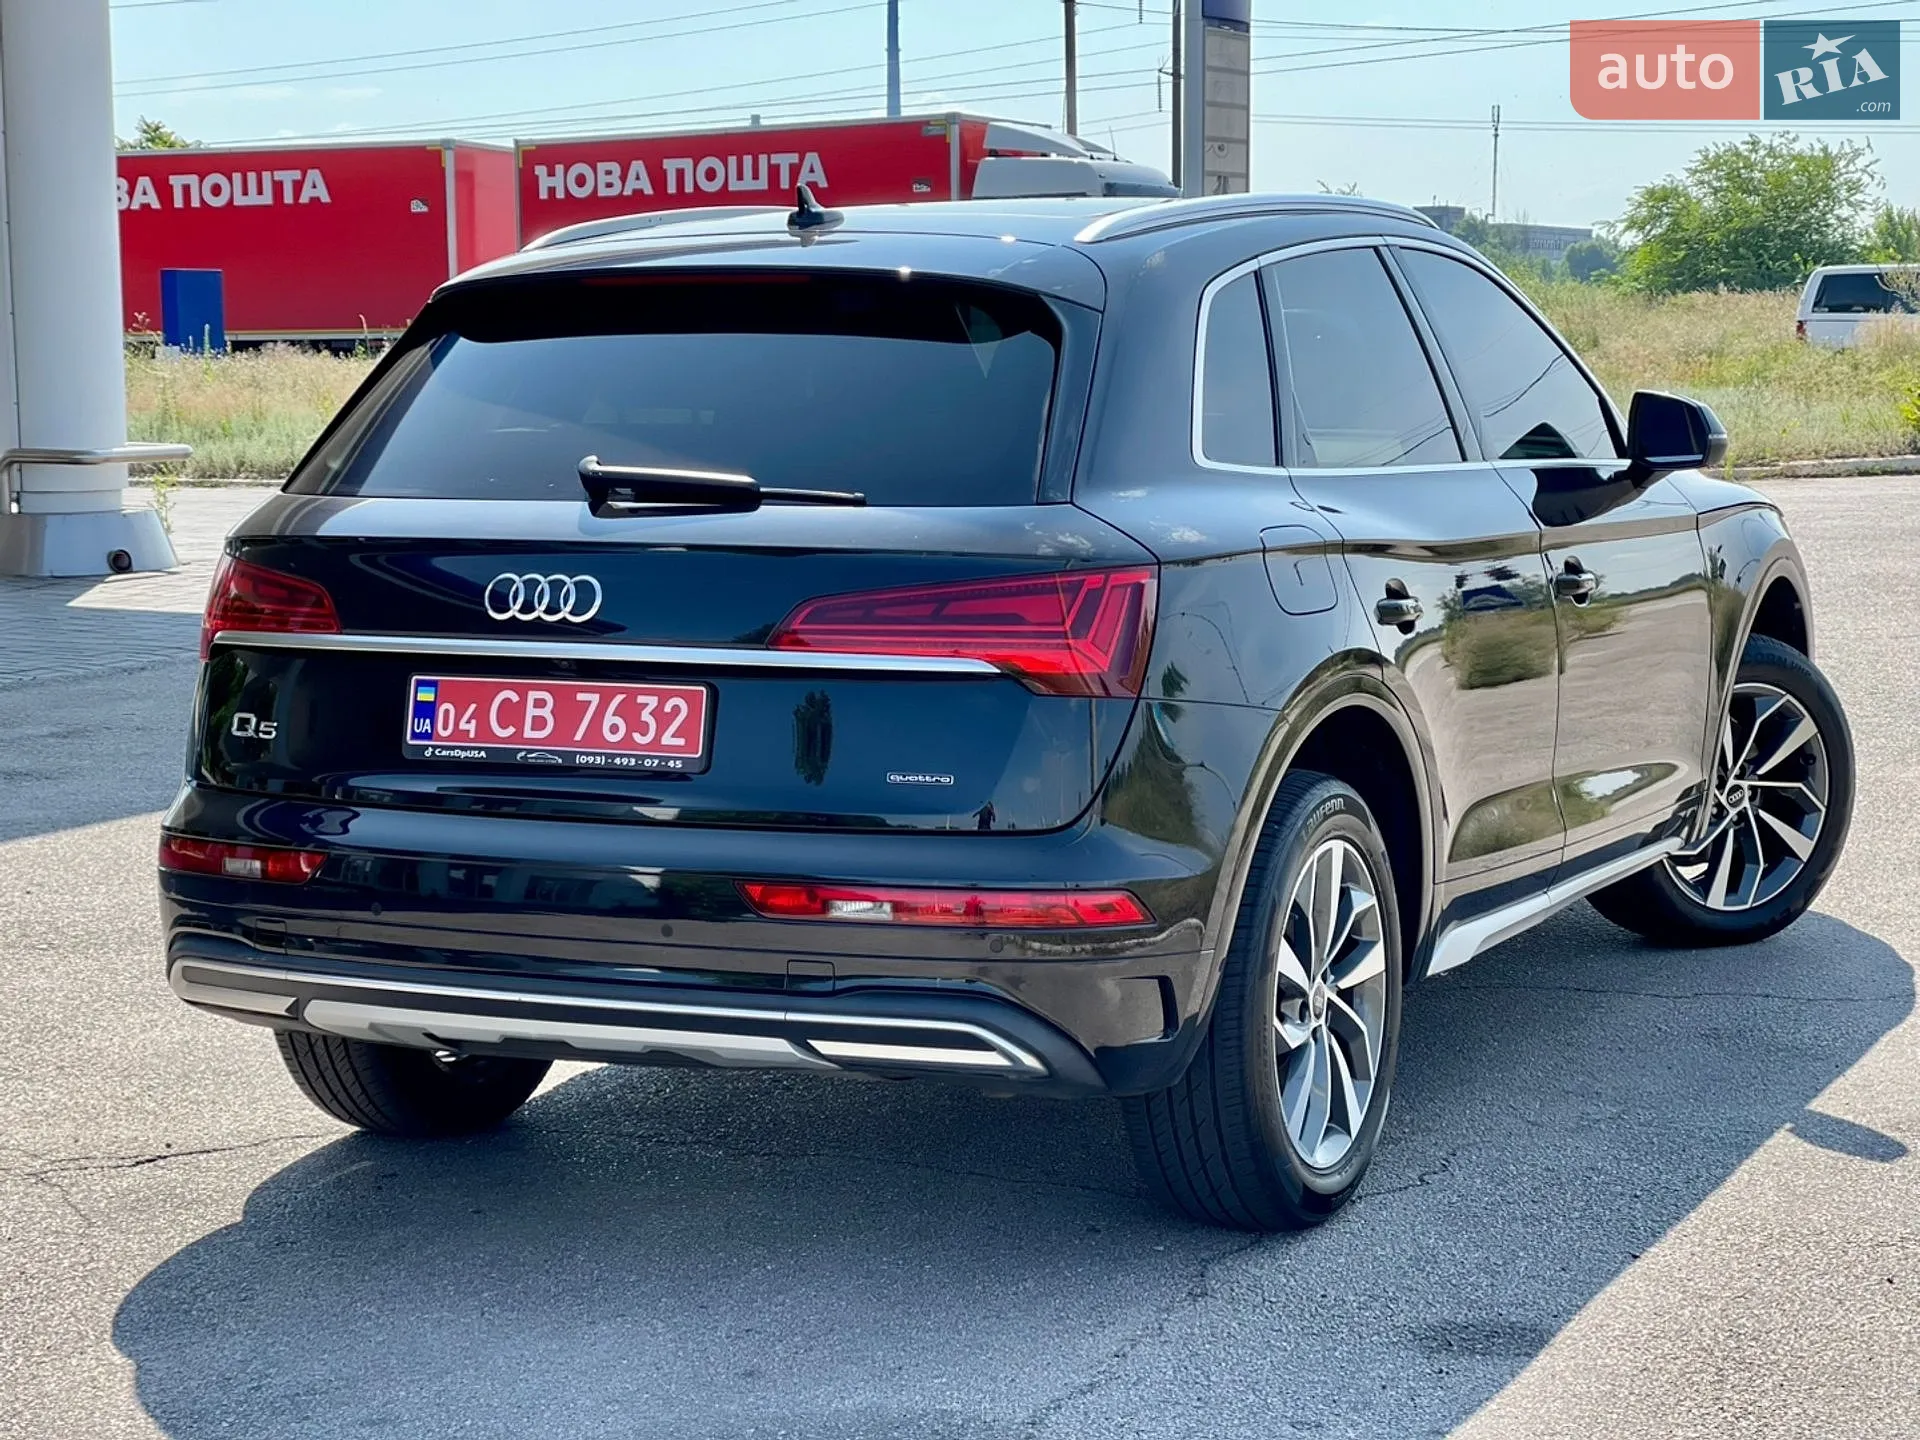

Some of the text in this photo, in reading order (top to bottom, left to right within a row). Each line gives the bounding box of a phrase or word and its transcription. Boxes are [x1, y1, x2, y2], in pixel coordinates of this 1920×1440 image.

[168, 168, 332, 209] ПОШТА
[534, 151, 828, 200] НОВА ПОШТА
[231, 712, 278, 739] Q5
[413, 717, 432, 734] UA
[437, 689, 689, 746] 04 CB 7632
[434, 747, 487, 759] CarsDpUSA
[889, 774, 951, 784] quattro
